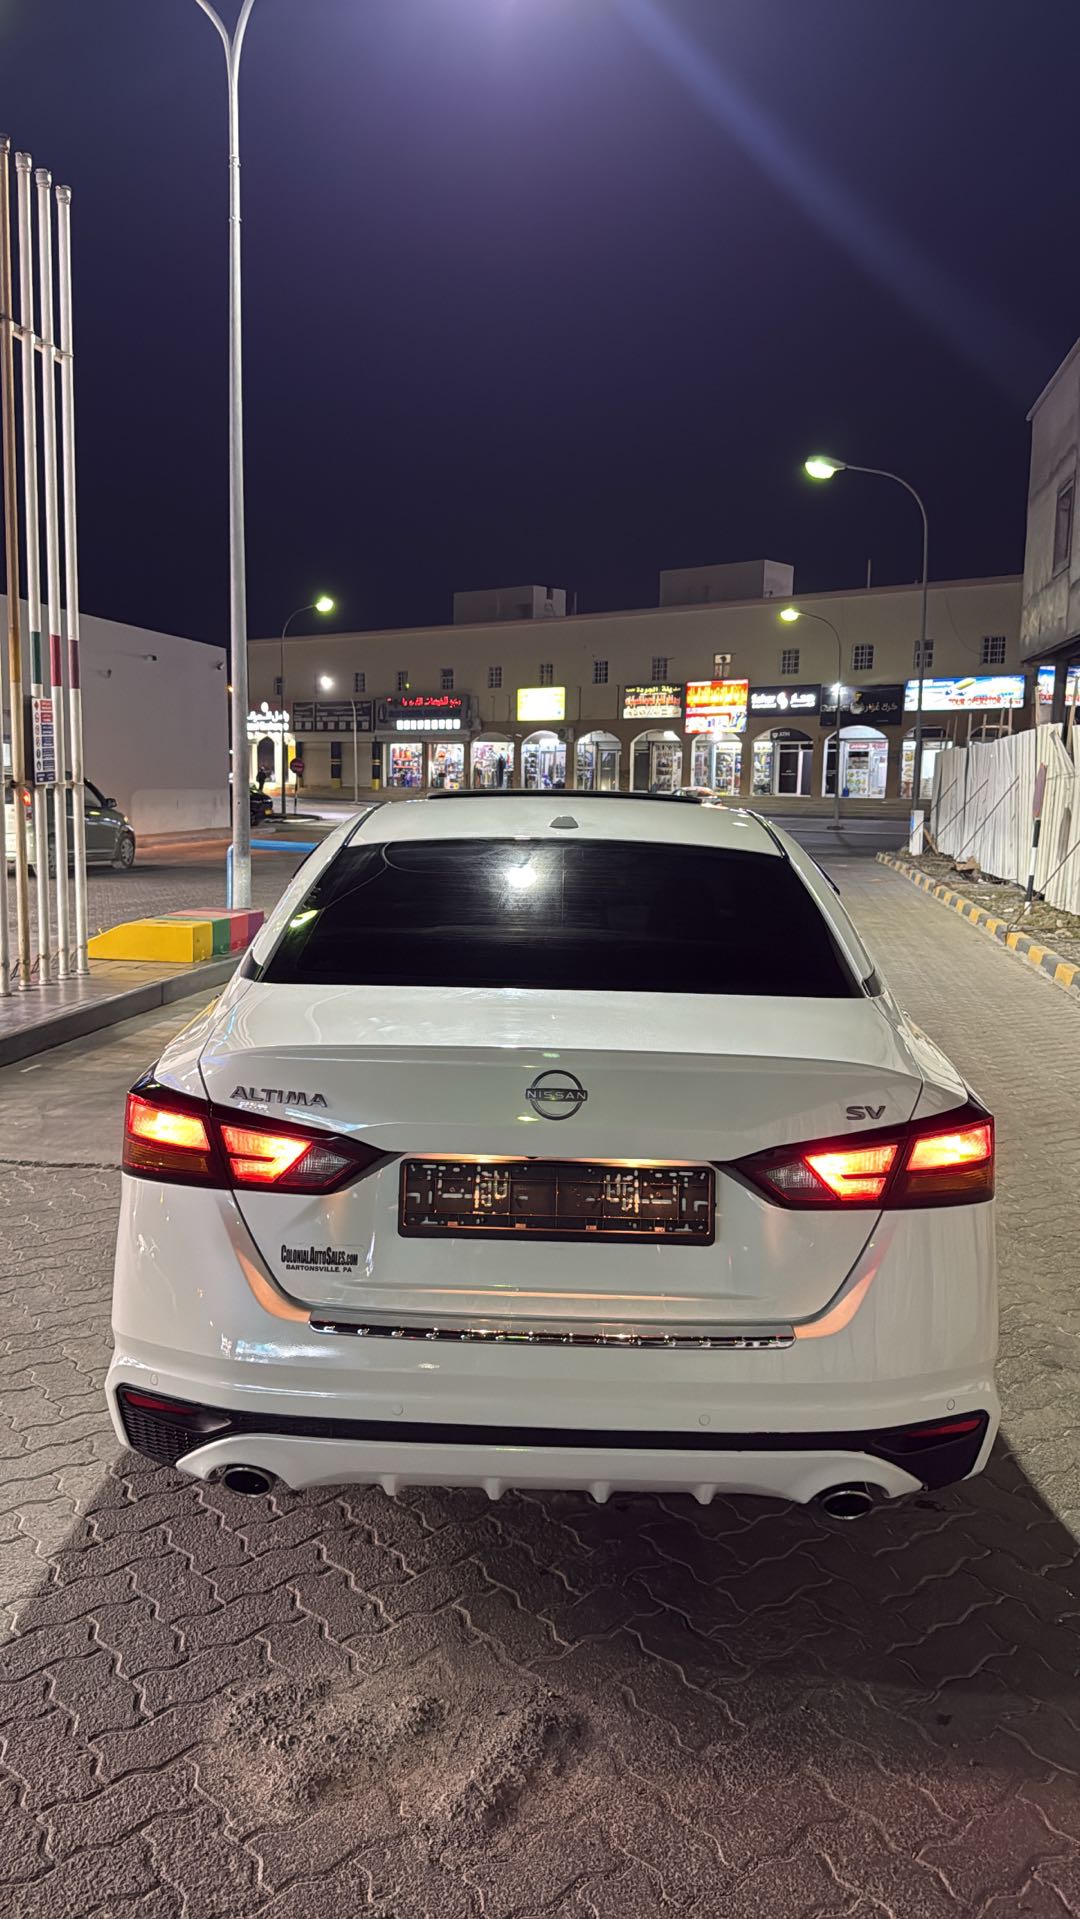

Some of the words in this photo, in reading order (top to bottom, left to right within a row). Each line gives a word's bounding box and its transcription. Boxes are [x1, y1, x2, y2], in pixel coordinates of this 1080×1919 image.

[229, 1086, 328, 1108] ALTIMA
[527, 1090, 586, 1100] NISSAN
[846, 1105, 887, 1121] SV
